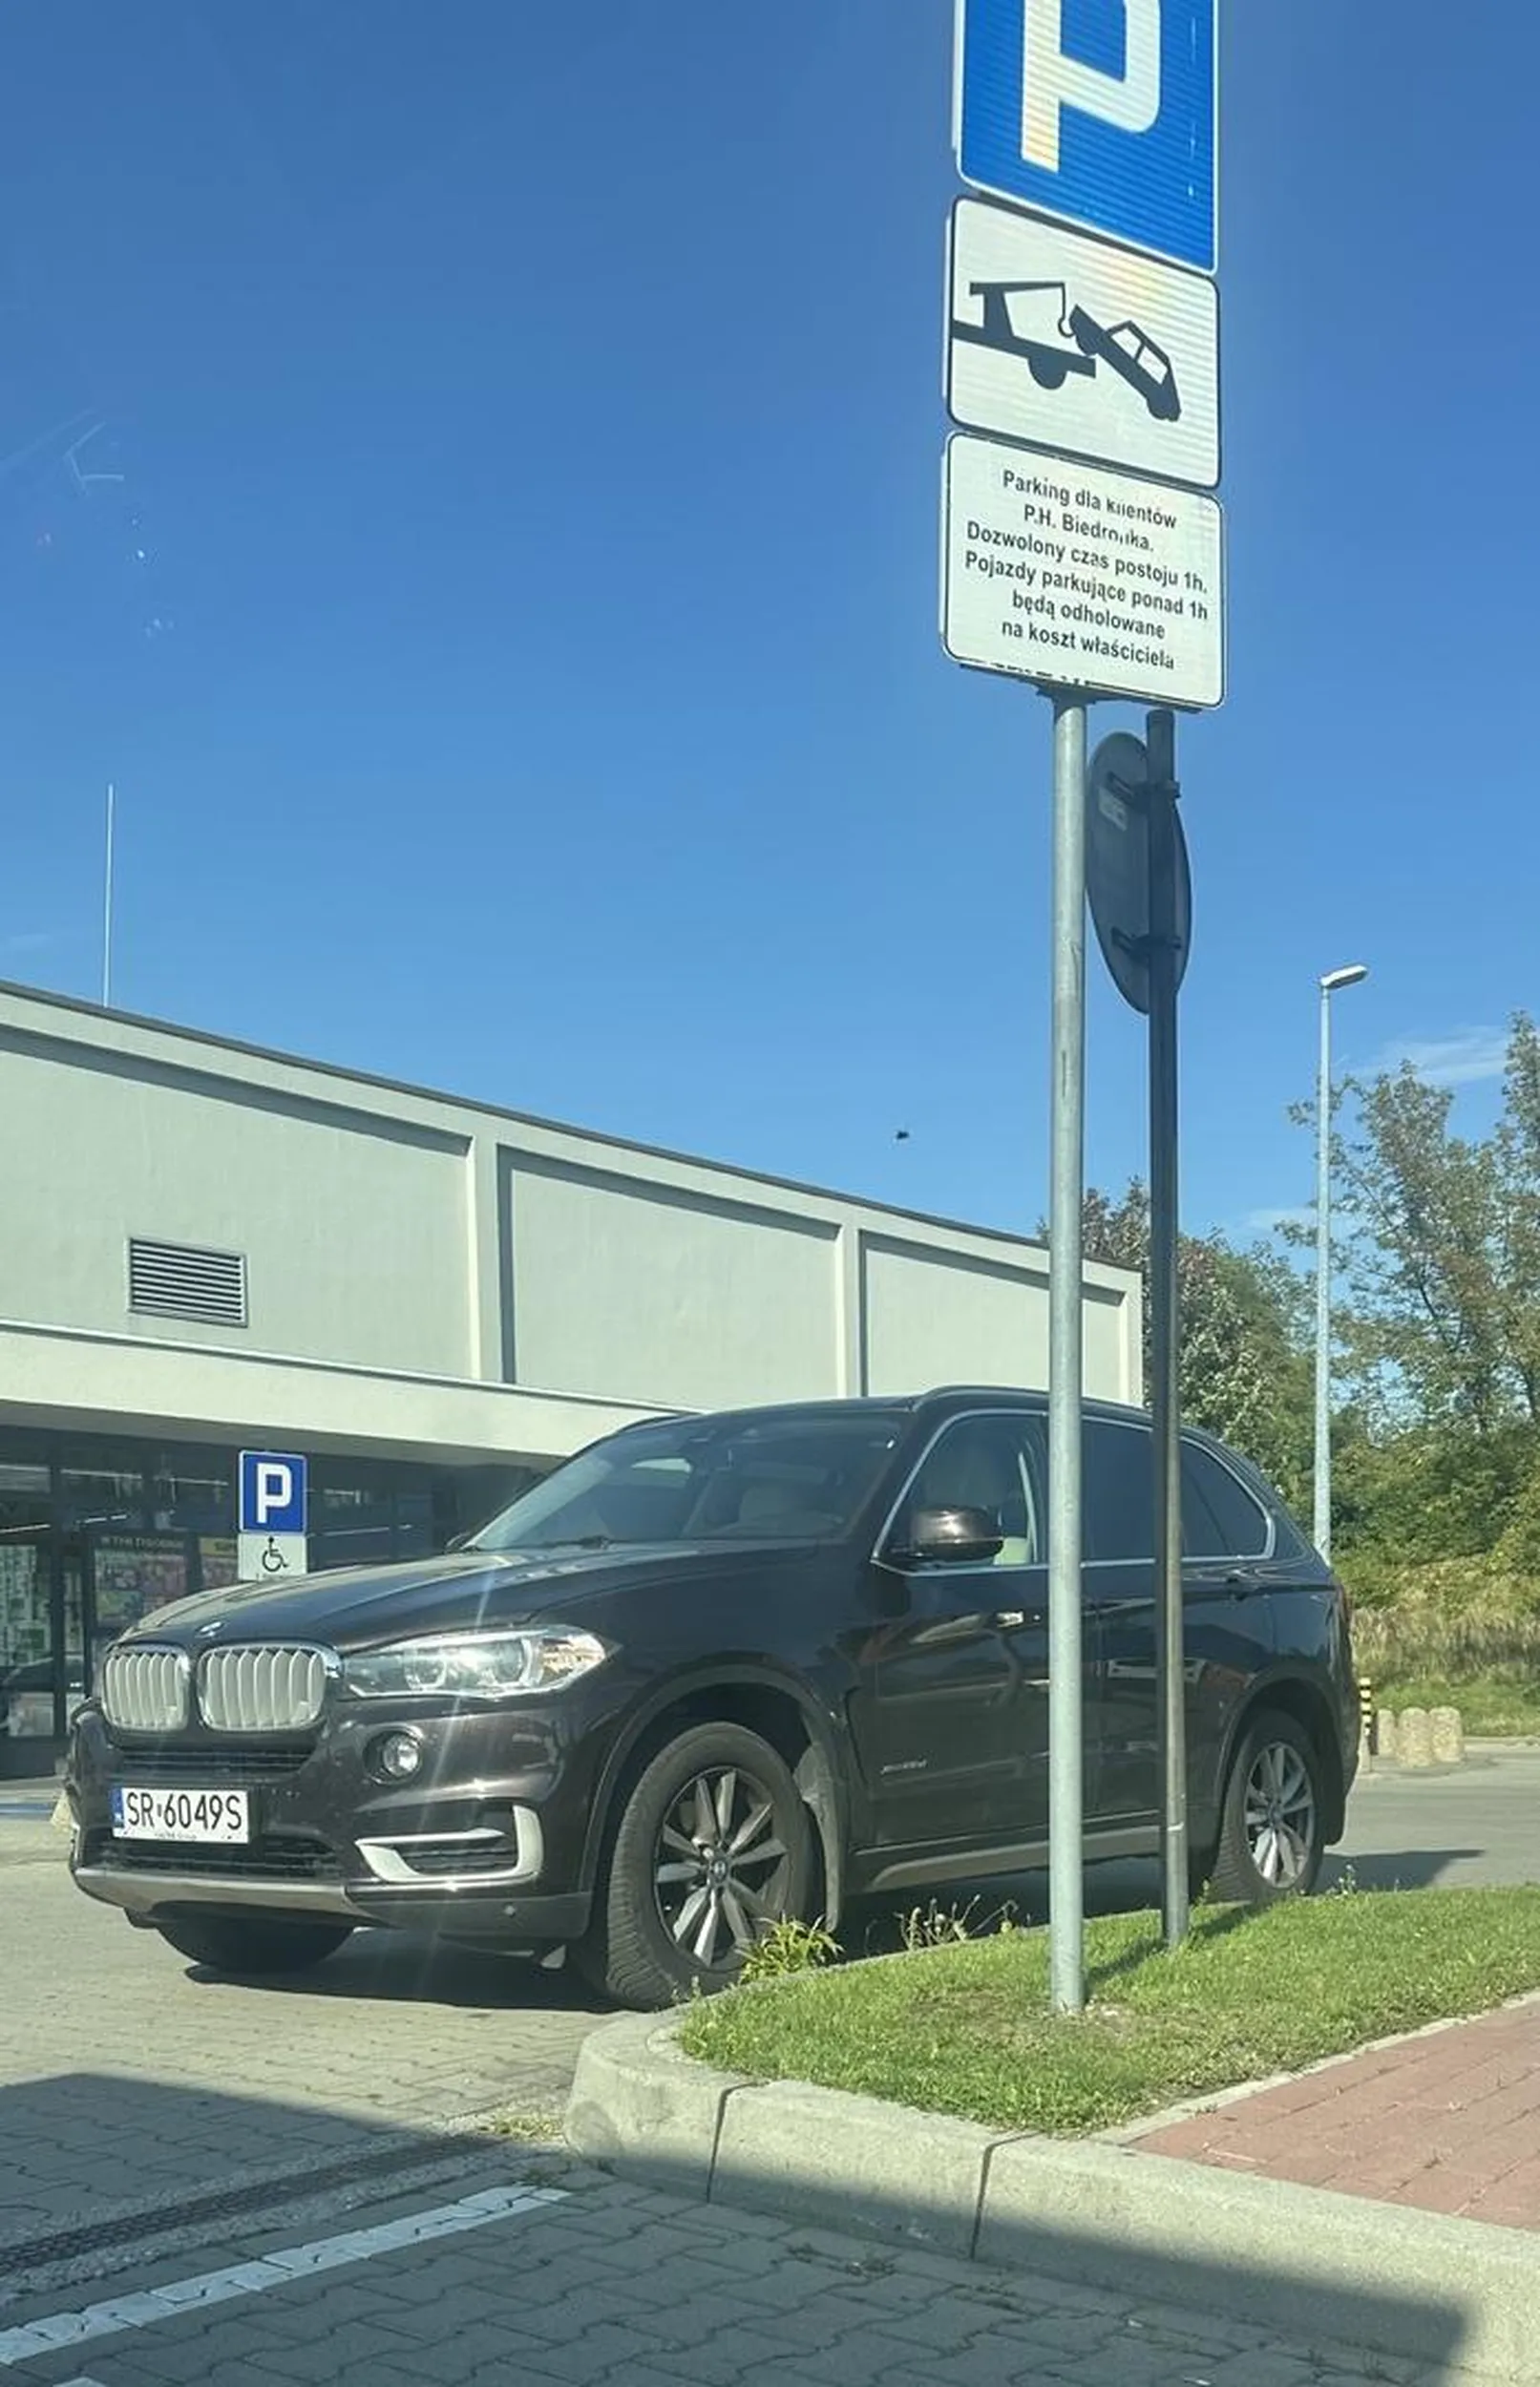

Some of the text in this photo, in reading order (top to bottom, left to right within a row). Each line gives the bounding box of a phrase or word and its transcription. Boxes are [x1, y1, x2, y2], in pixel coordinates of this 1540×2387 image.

[1021, 0, 1161, 173] P
[1003, 470, 1070, 506] Parking
[1075, 489, 1101, 511] dla
[1023, 504, 1056, 529] P.H.
[967, 520, 1208, 594] Dozwolony czas postoju 1h.
[965, 550, 1208, 621] Pojazdy parkujące ponad 1h
[1012, 590, 1166, 640] będą odholowane
[1002, 622, 1174, 670] na koszt właściciela
[257, 1462, 292, 1524] P
